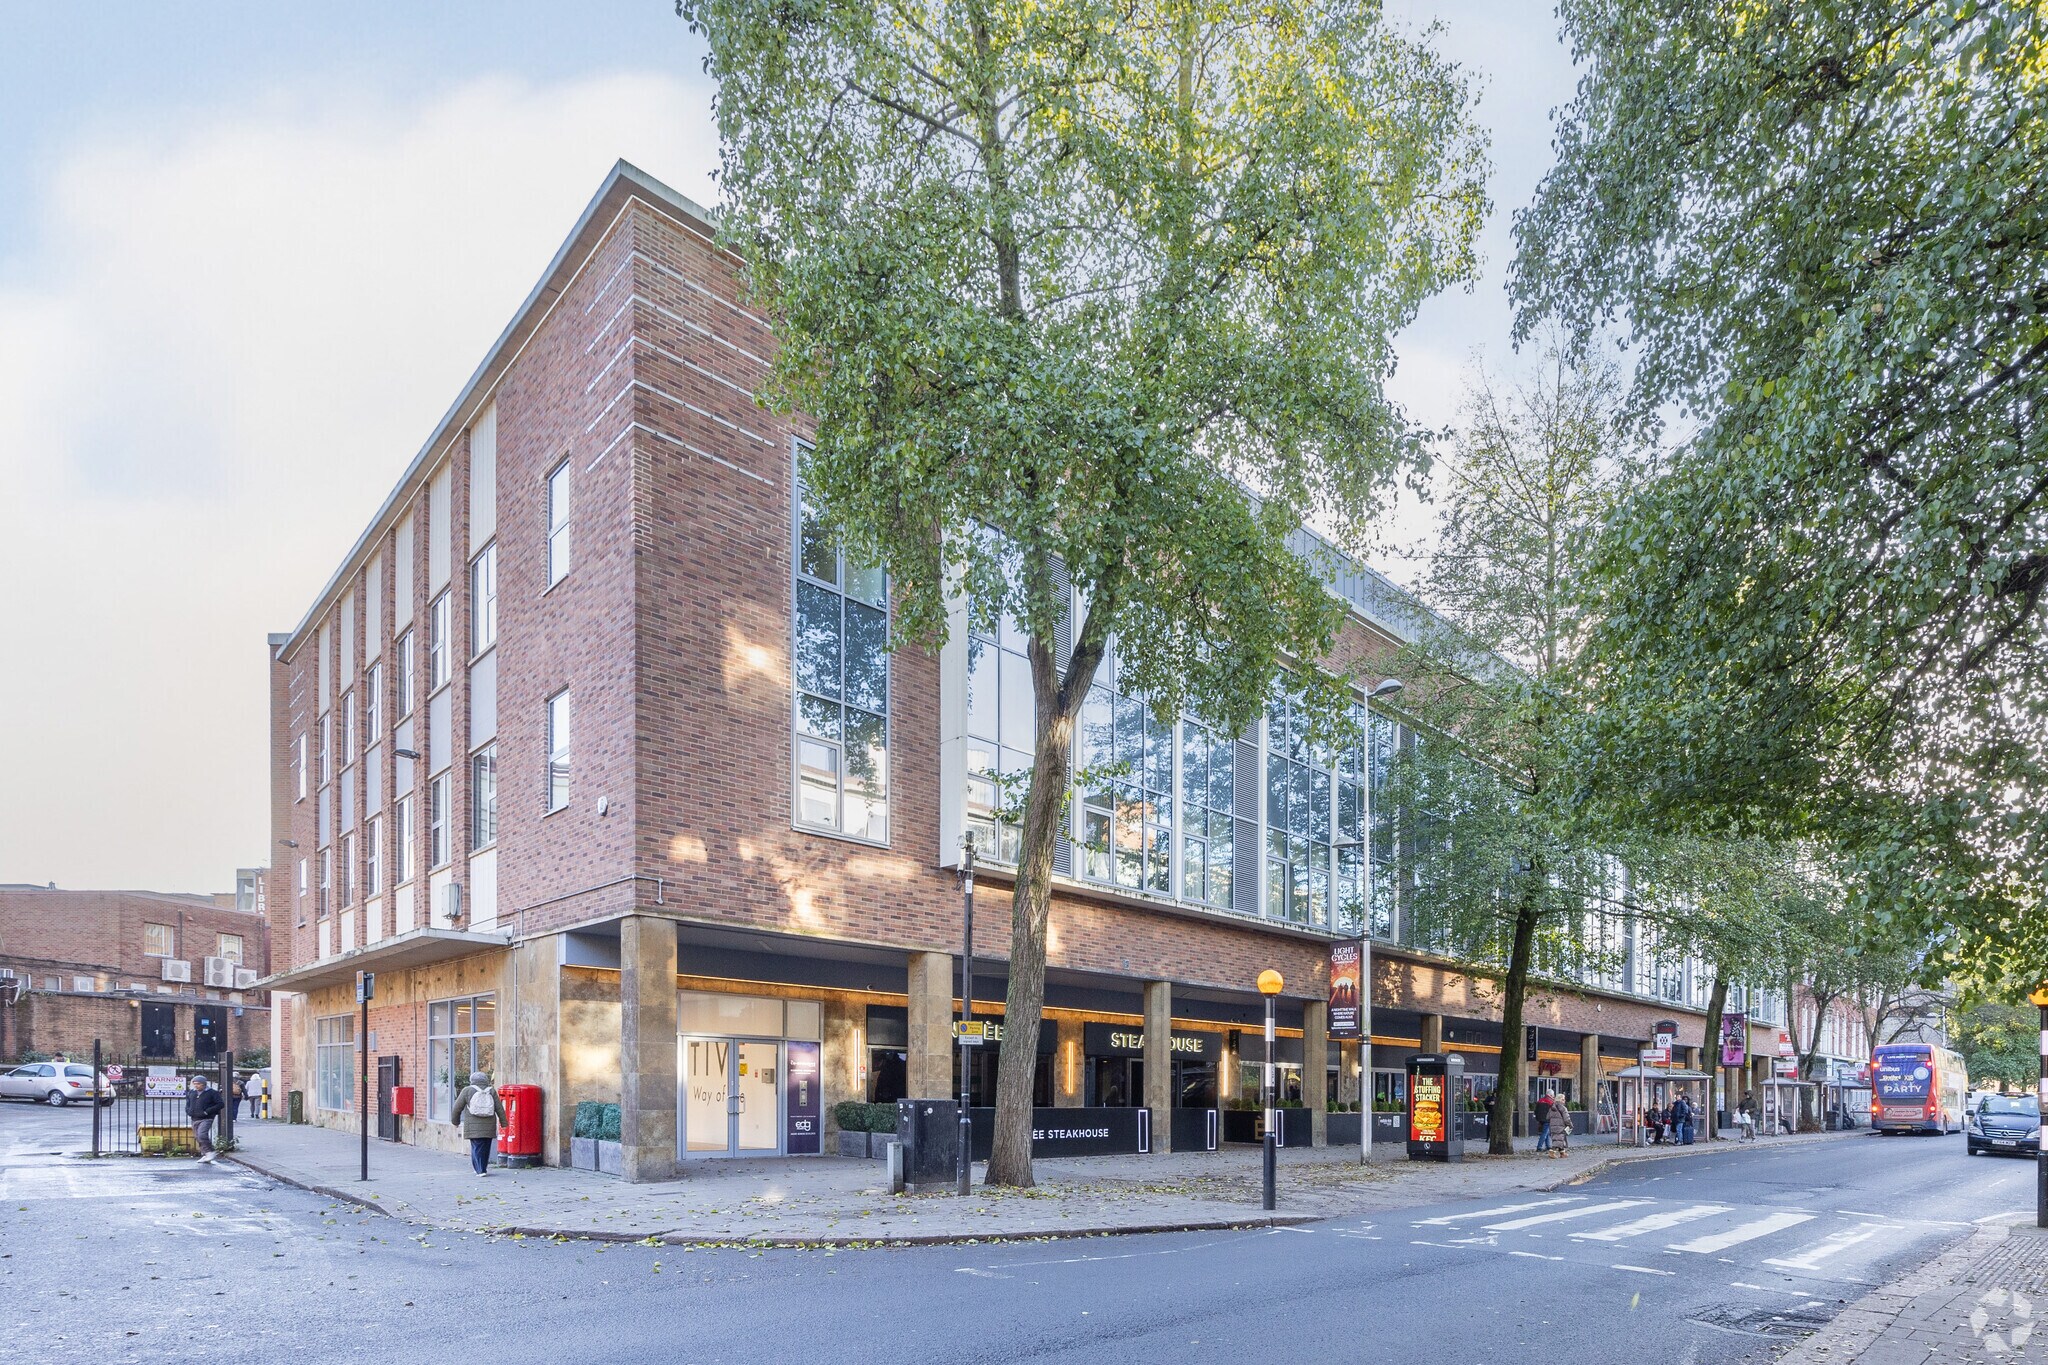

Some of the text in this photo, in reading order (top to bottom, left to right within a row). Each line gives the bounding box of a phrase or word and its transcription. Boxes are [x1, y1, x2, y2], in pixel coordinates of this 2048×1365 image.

[1331, 953, 1358, 961] CYCLES
[1422, 1077, 1433, 1085] THE
[1414, 1085, 1441, 1094] STUFFING
[693, 1086, 712, 1106] Way
[715, 1084, 726, 1102] of
[1415, 1093, 1440, 1102] STACKER
[1048, 1128, 1109, 1139] STEAKHOUSE
